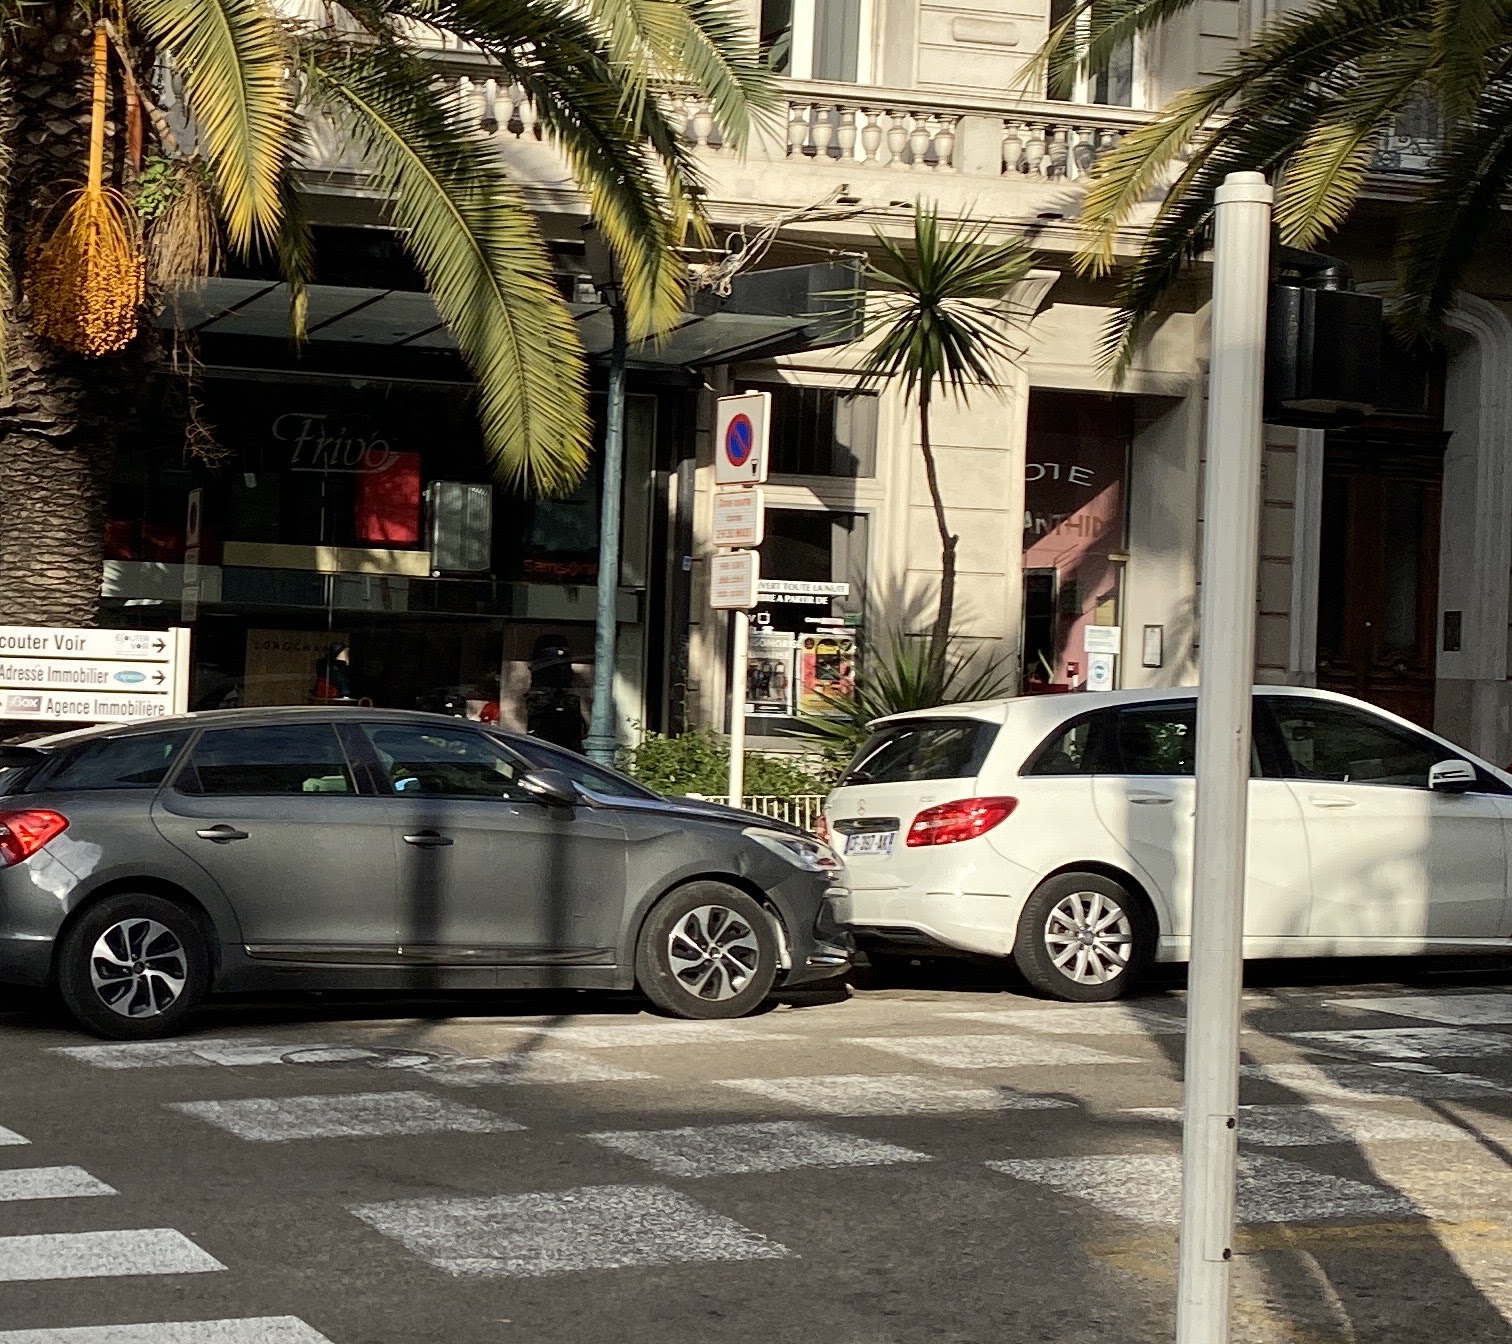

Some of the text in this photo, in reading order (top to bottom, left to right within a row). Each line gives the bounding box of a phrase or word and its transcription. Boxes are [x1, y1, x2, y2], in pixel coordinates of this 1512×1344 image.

[54, 633, 86, 651] Voir
[47, 665, 109, 685] Immobilier
[45, 697, 91, 718] Agence
[94, 698, 166, 717] Immobilière
